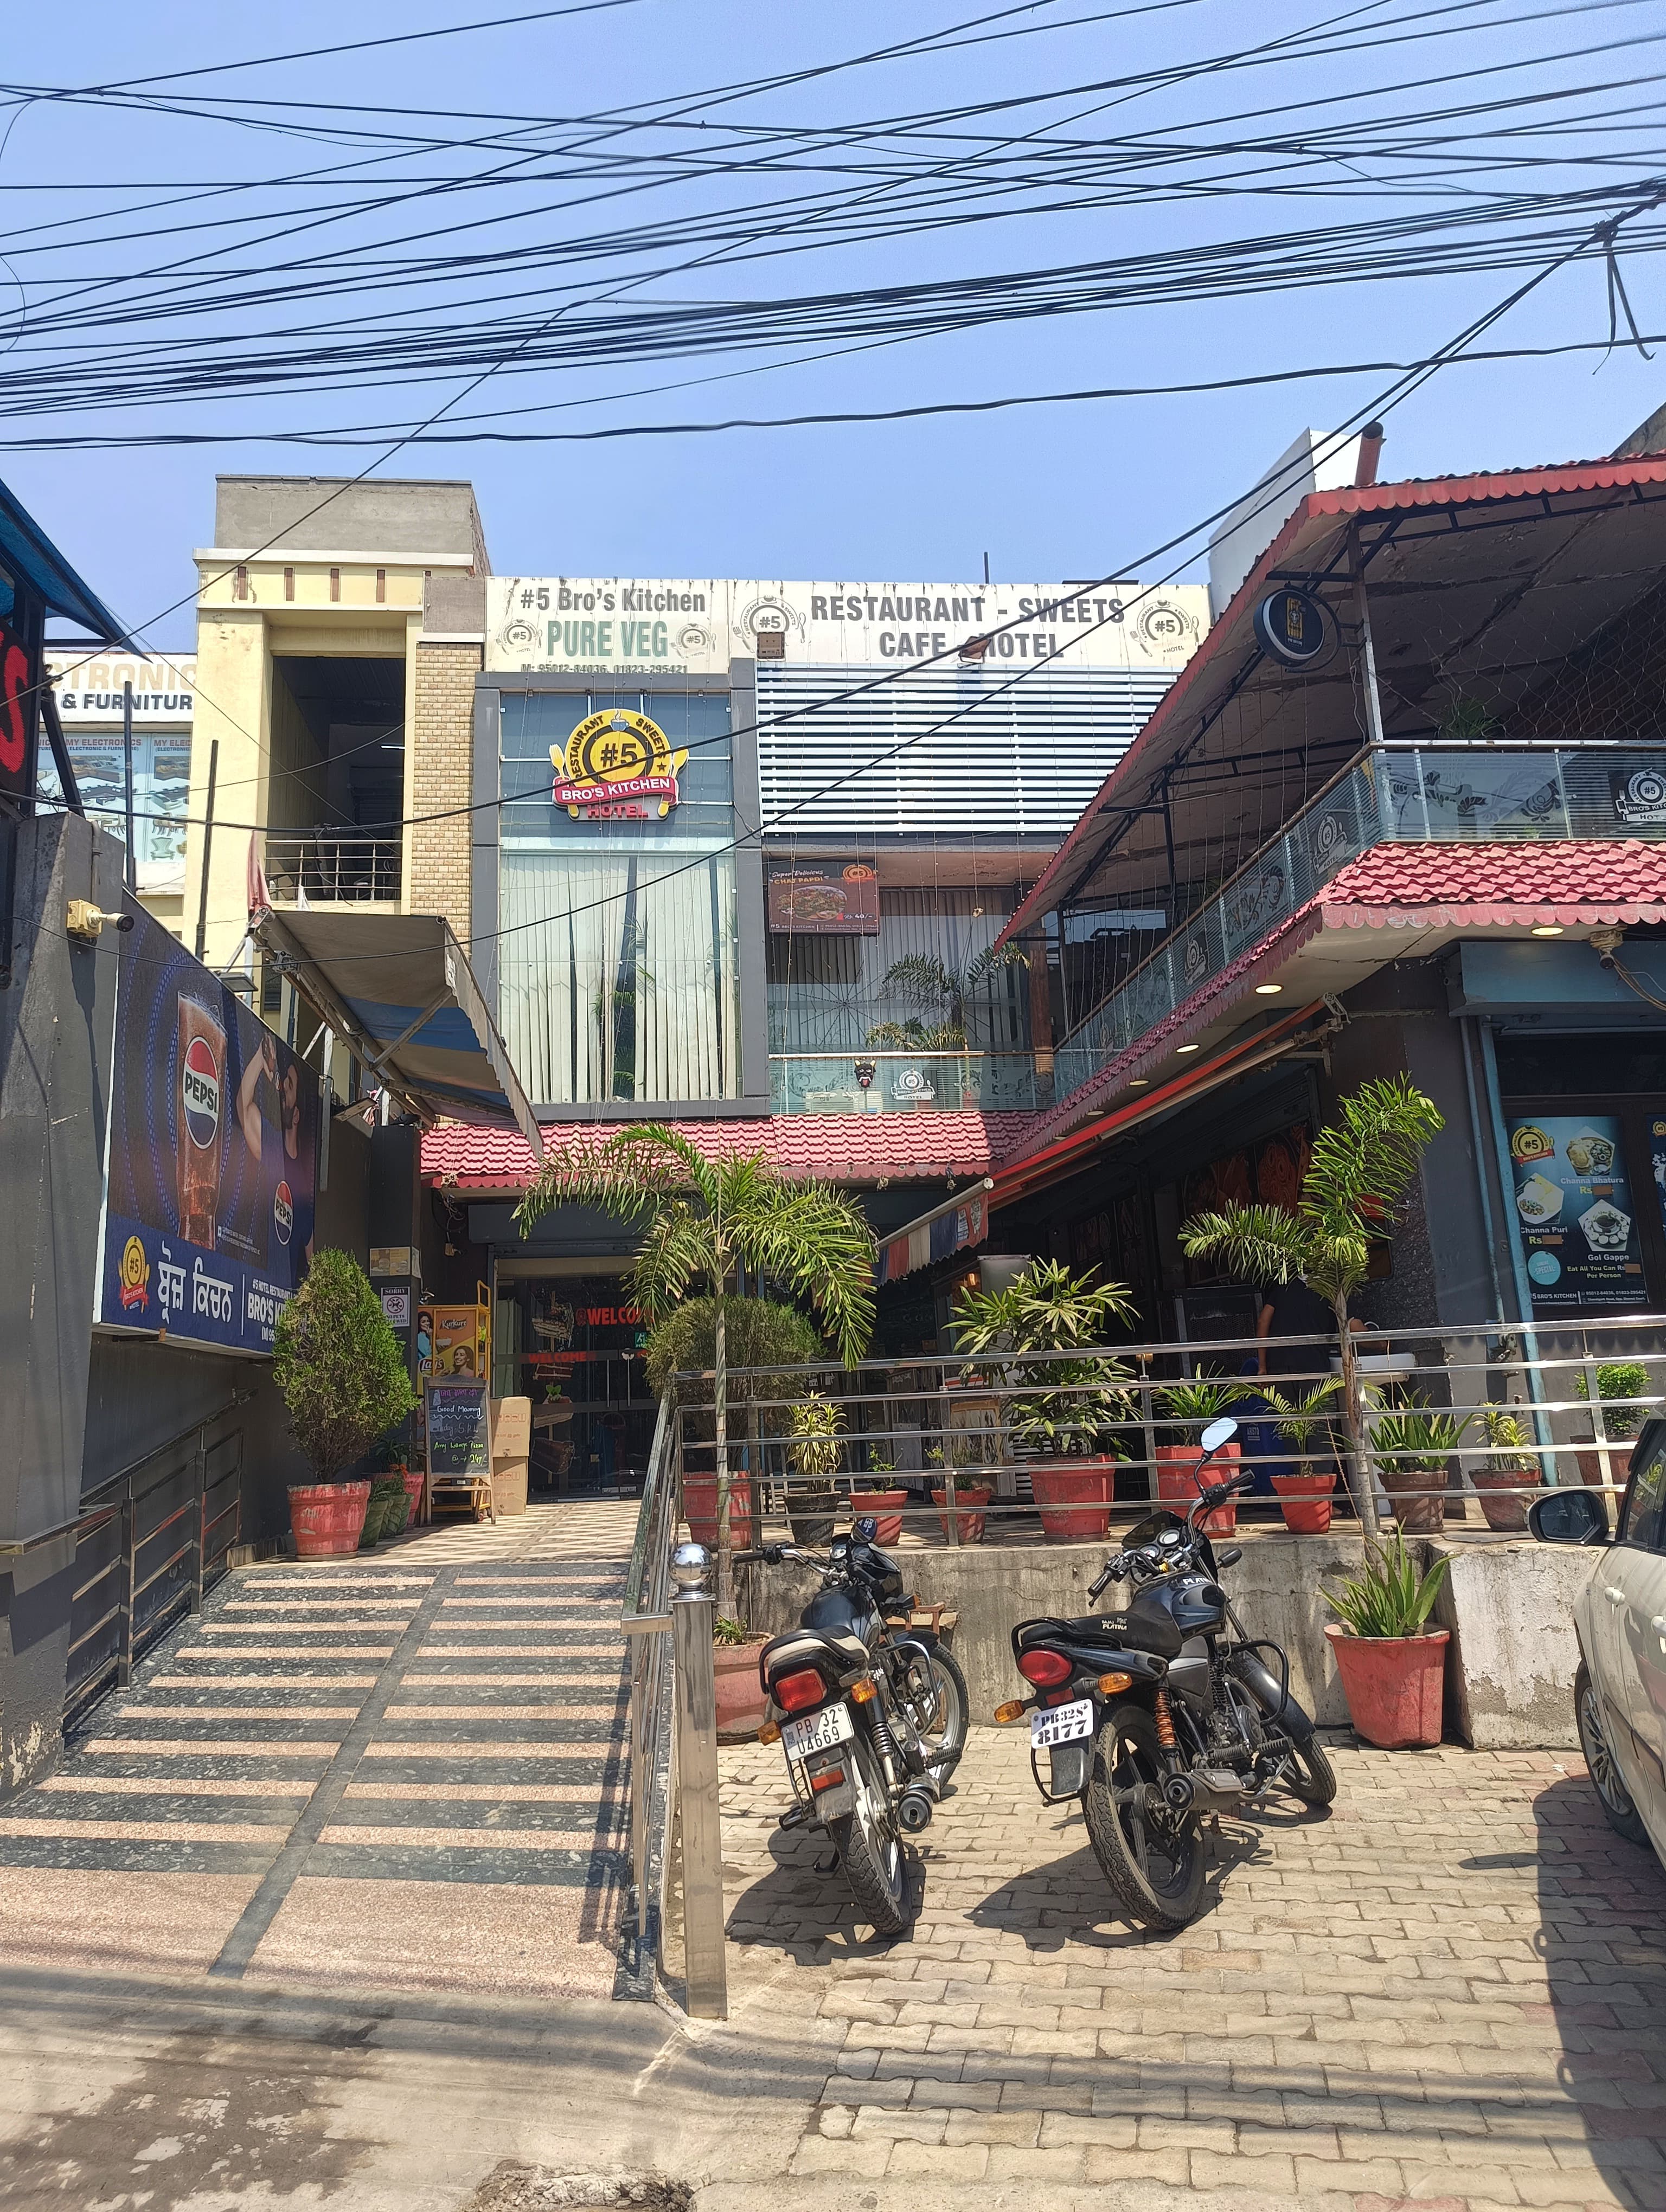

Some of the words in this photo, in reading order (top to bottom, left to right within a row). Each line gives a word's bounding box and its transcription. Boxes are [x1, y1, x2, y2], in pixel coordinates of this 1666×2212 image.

[521, 587, 549, 610] #5
[559, 588, 615, 611] Bro's
[621, 588, 705, 612] Kitchen
[811, 596, 985, 621] RESTAURANT
[1018, 597, 1125, 623] SWEETS
[759, 616, 781, 629] #5
[1155, 620, 1175, 633] #5
[512, 632, 526, 640] #5
[548, 620, 612, 657] PURE
[621, 620, 668, 657] VEG
[685, 635, 701, 644] #5
[880, 632, 946, 657] CAFE
[62, 693, 77, 709] &
[600, 743, 638, 768] #5
[562, 788, 605, 800] BRO'S
[607, 778, 670, 795] KITCHEN
[586, 805, 649, 819] HOTEL
[185, 1071, 217, 1113] PEPSI
[1524, 1140, 1539, 1149] #5
[275, 1198, 292, 1225] PEPSI
[1529, 1236, 1542, 1244] Rs
[130, 1257, 138, 1274] #5
[193, 1256, 234, 1323] ਕਿਚਨ
[248, 1292, 274, 1325] BRO'S
[586, 1307, 654, 1326] WELCO
[442, 1319, 466, 1329] Kurkure
[529, 1352, 586, 1364] WELCOME
[437, 1405, 455, 1413] Good
[458, 1405, 480, 1417] Morning
[434, 1442, 447, 1454] Any
[469, 1441, 483, 1449] Pizza
[796, 1719, 813, 1738] PB
[821, 1709, 838, 1727] 32
[1038, 1719, 1087, 1744] 8177
[797, 1726, 840, 1754] U4669
